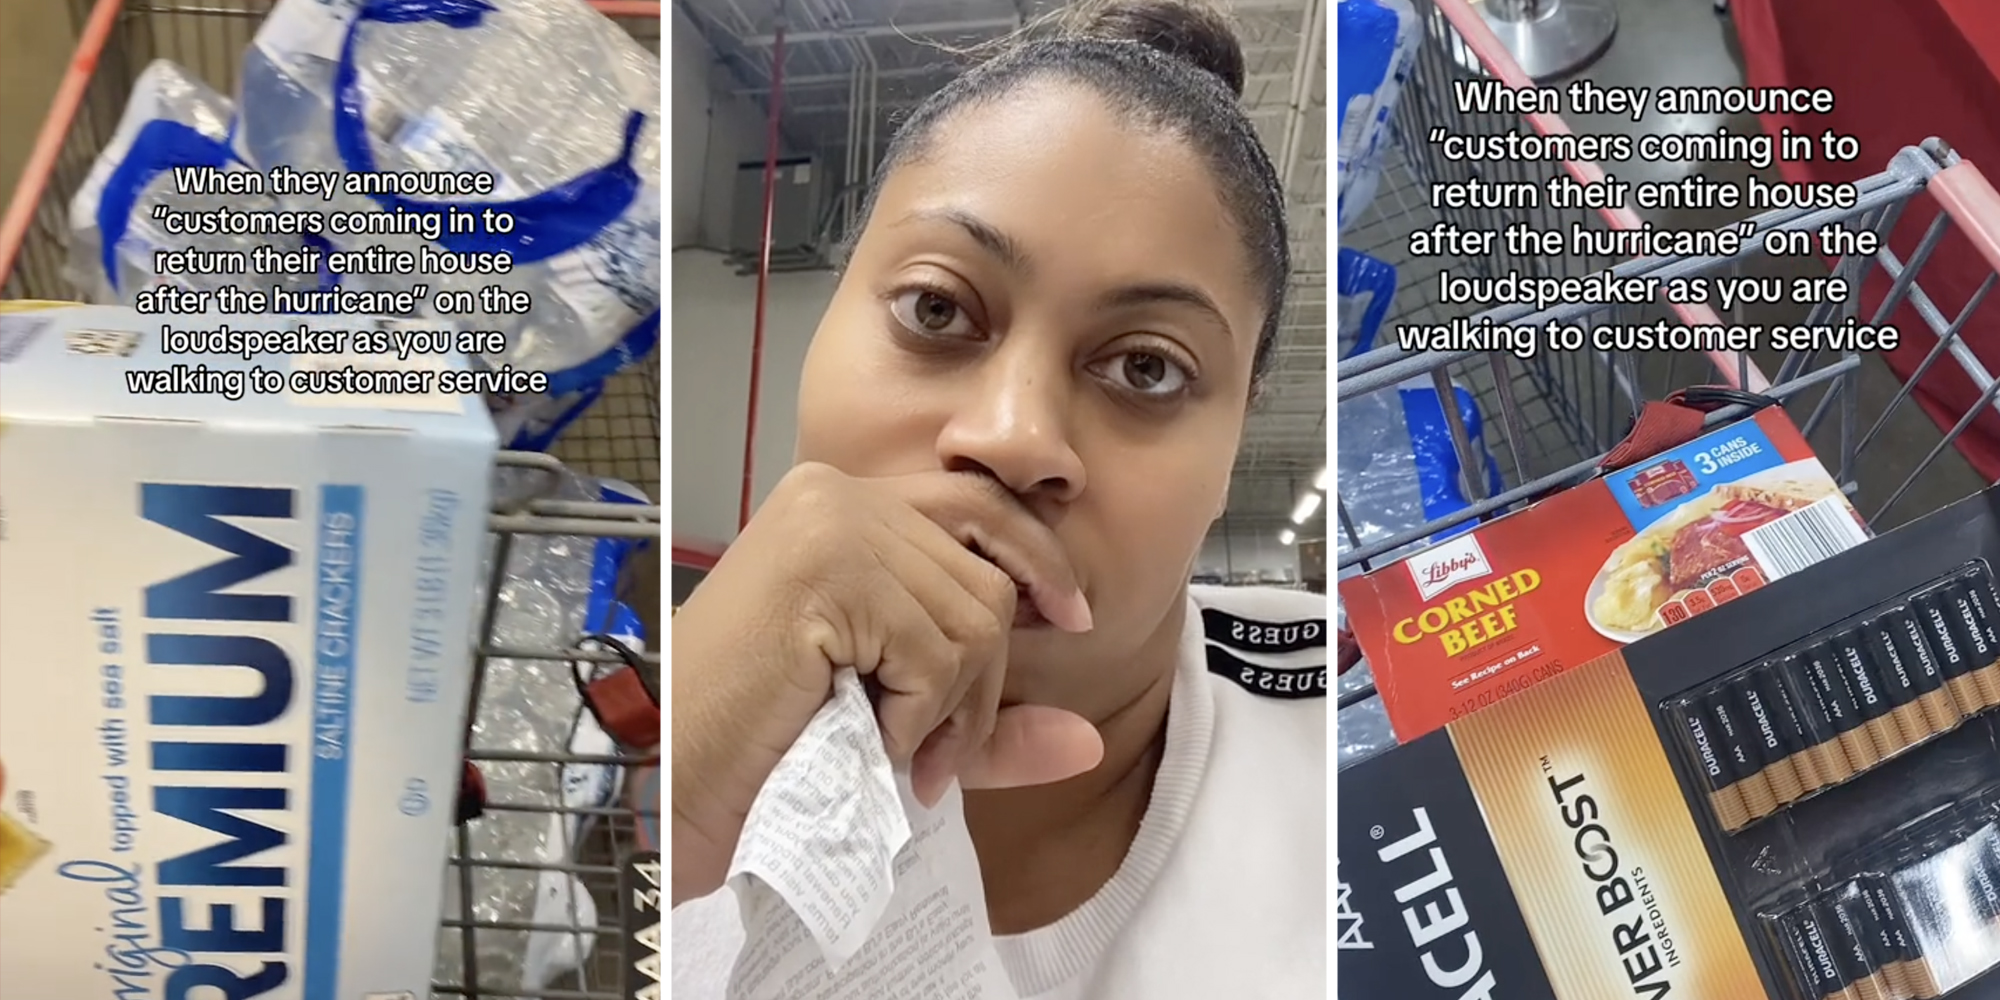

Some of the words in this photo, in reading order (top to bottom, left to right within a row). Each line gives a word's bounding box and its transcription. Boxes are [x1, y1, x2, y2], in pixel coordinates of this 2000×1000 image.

[1710, 436, 1748, 458] CANS
[1717, 442, 1763, 468] INSIDE
[1694, 452, 1718, 475] 3
[1422, 552, 1477, 588] Libby's
[1393, 568, 1541, 644] CORNED
[1663, 605, 1687, 625] 130
[89, 607, 123, 654] salt
[1439, 604, 1518, 657] BEEF
[1984, 626, 1999, 645] AAA
[1452, 676, 1470, 690] See
[1470, 662, 1503, 679] Recipe
[1503, 655, 1518, 667] on
[1517, 644, 1541, 661] Back
[101, 664, 126, 709] sea
[1449, 699, 1478, 720] 3-12
[1478, 690, 1496, 708] OZ
[1496, 673, 1533, 704] (340G)
[1532, 658, 1565, 682] CANS
[1829, 698, 1844, 720] AAA
[95, 717, 127, 766] with
[1732, 744, 1747, 764] AAA
[100, 775, 139, 852] topped
[1631, 866, 1681, 968] INGREDIENTS
[1851, 943, 1865, 963] AAA
[1879, 929, 1892, 948] AAA
[1894, 929, 1907, 948] AAA
